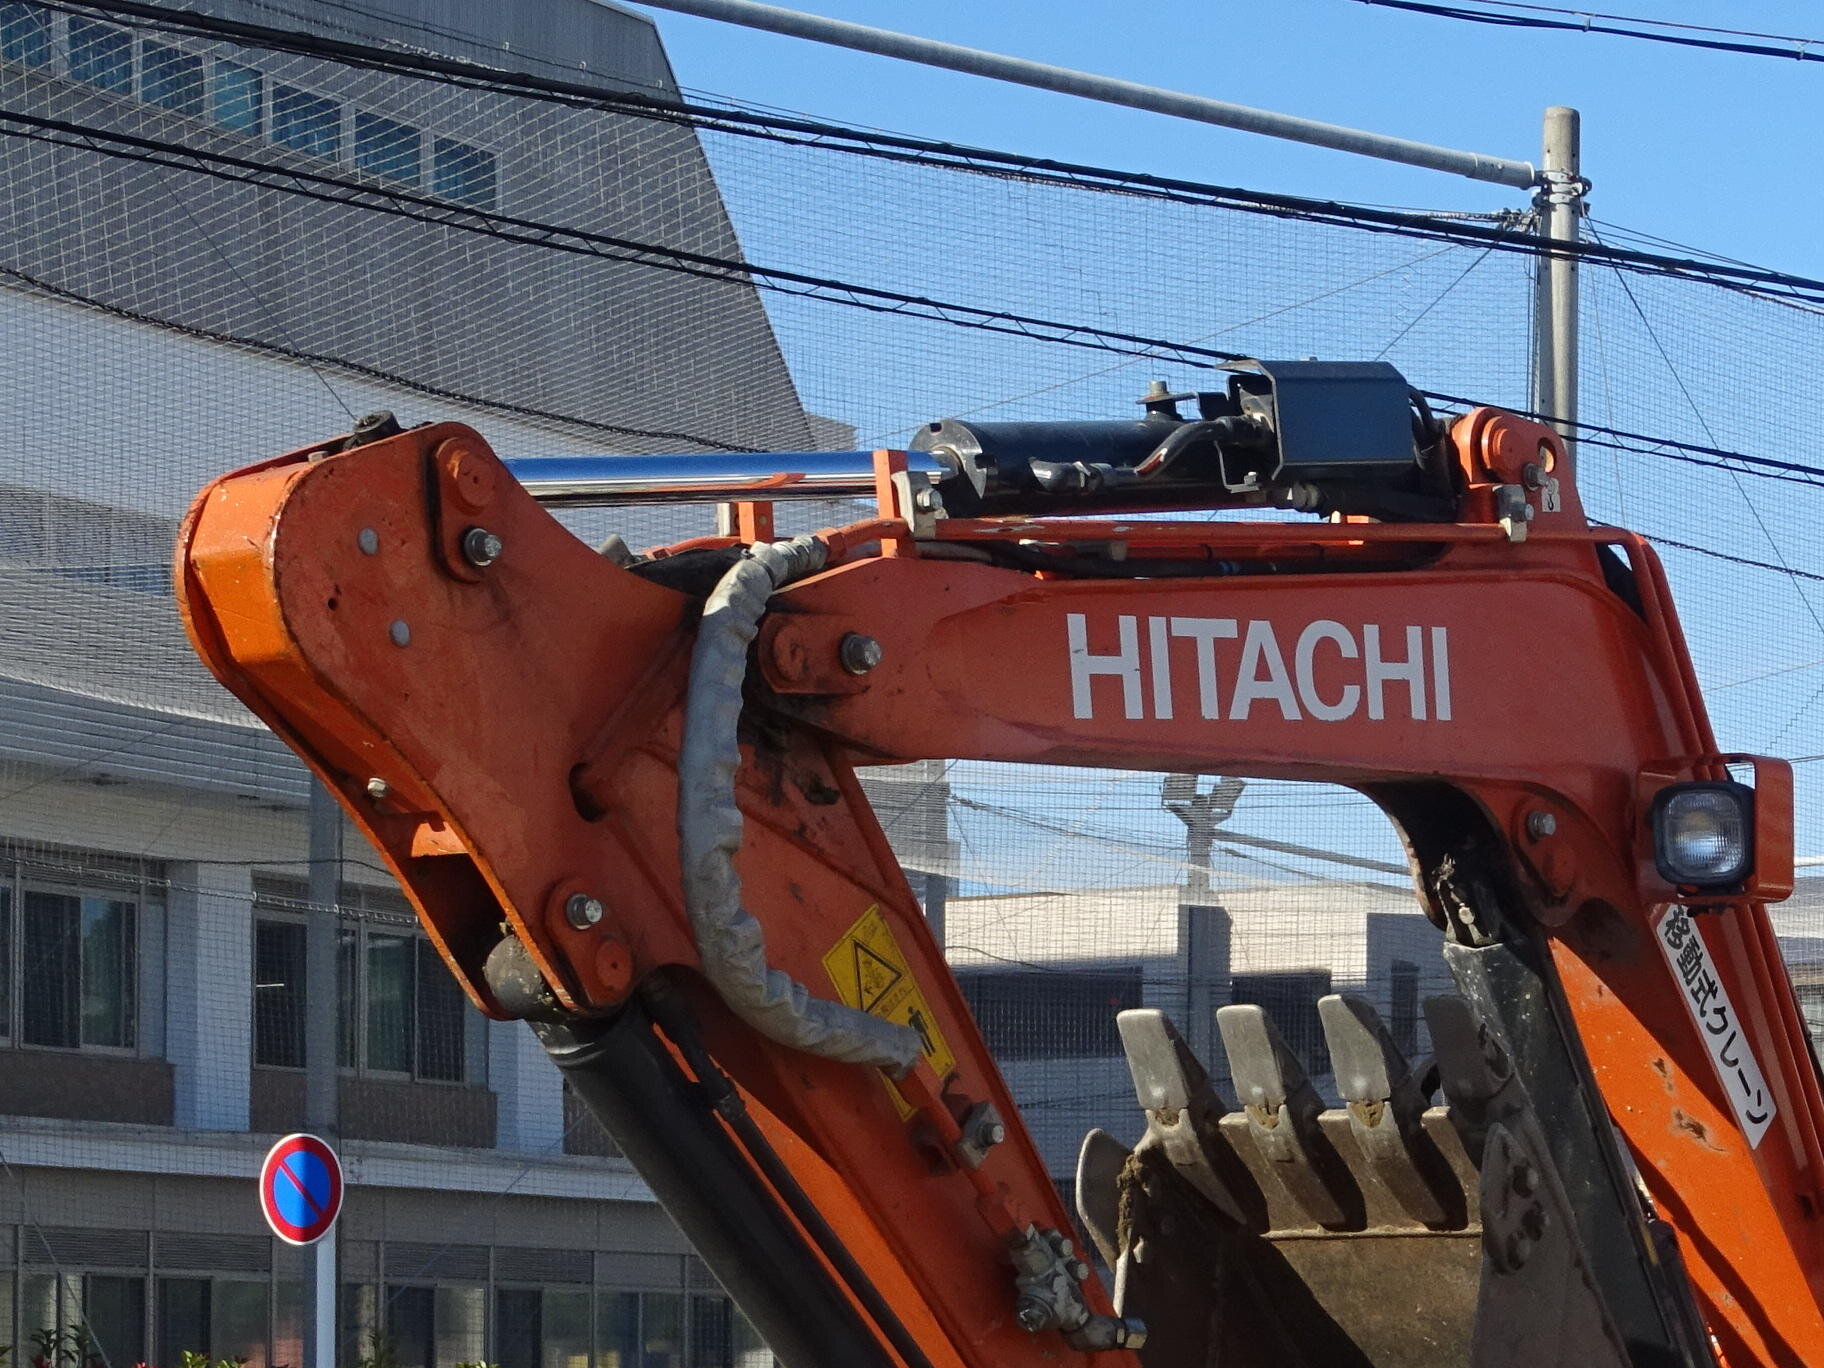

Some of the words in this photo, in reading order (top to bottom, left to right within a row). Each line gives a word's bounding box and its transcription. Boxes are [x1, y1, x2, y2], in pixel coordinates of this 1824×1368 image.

[1067, 613, 1452, 721] HITACHI
[1664, 904, 1769, 1125] 移動式クレーン
